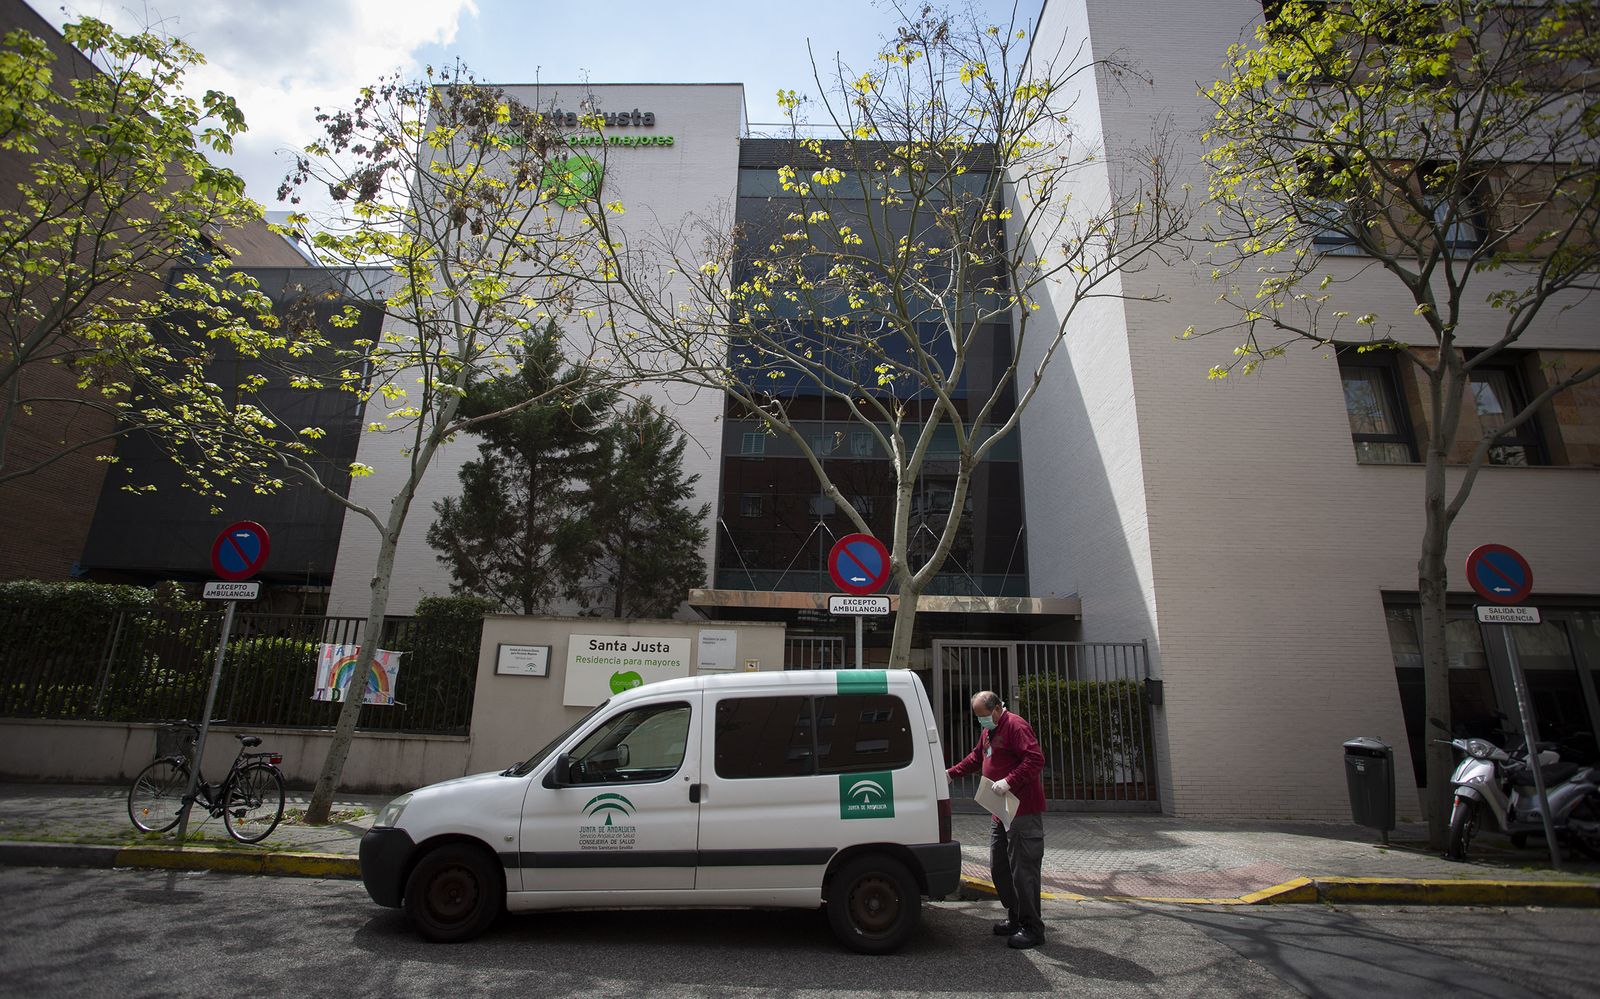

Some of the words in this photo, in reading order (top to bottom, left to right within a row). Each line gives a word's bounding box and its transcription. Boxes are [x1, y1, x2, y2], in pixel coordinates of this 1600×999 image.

[568, 135, 602, 147] para
[608, 134, 674, 148] mayores
[589, 639, 627, 652] Santa
[631, 641, 670, 653] Justa
[575, 655, 621, 664] Residencia
[623, 658, 642, 666] para
[644, 658, 680, 667] mayores
